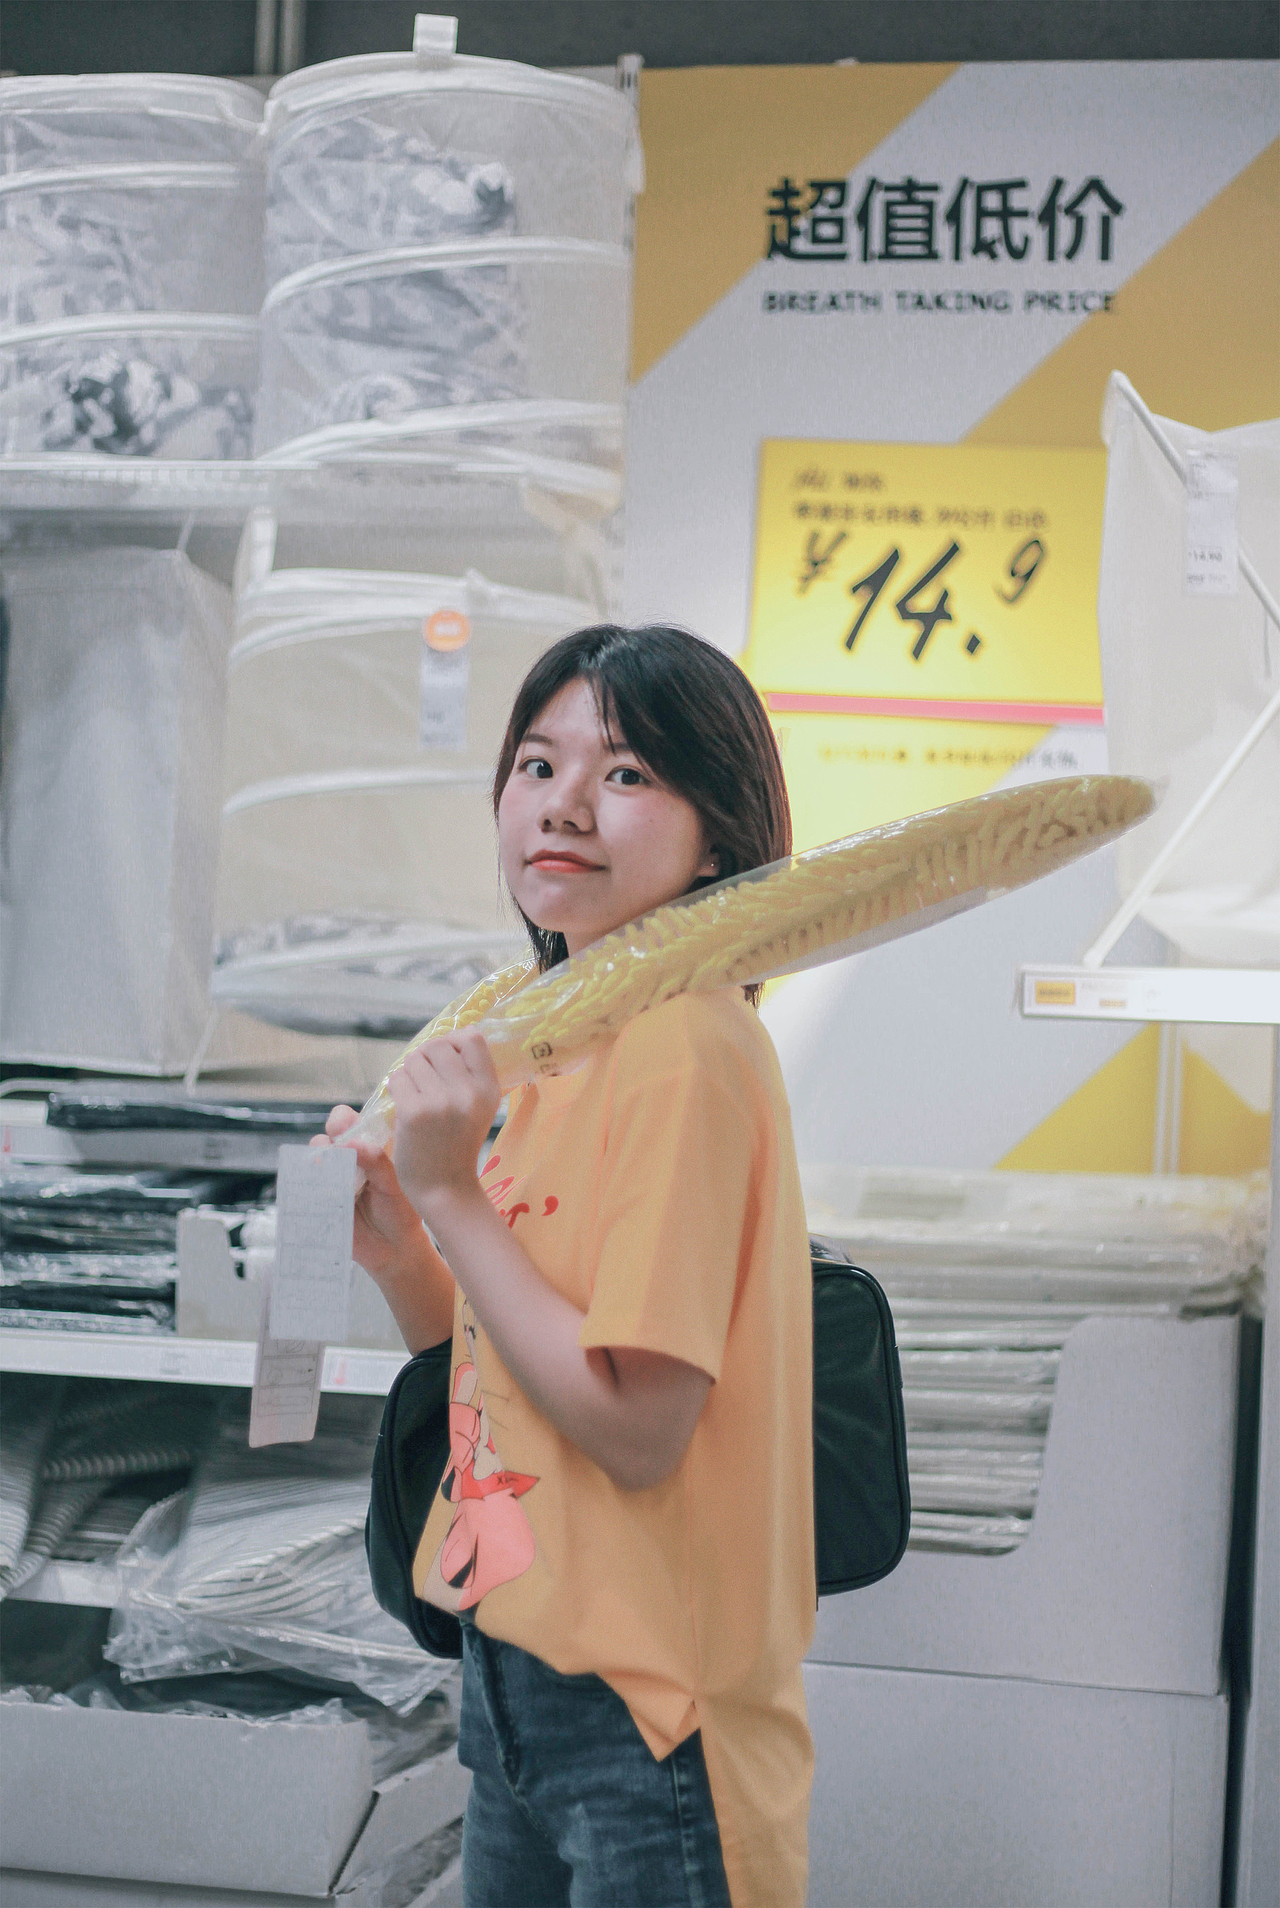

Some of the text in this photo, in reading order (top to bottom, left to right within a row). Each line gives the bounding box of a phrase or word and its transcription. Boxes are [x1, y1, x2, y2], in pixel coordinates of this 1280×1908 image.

[766, 177, 1123, 261] 超值低价
[763, 290, 1114, 312] BREATH TAKING PRICE
